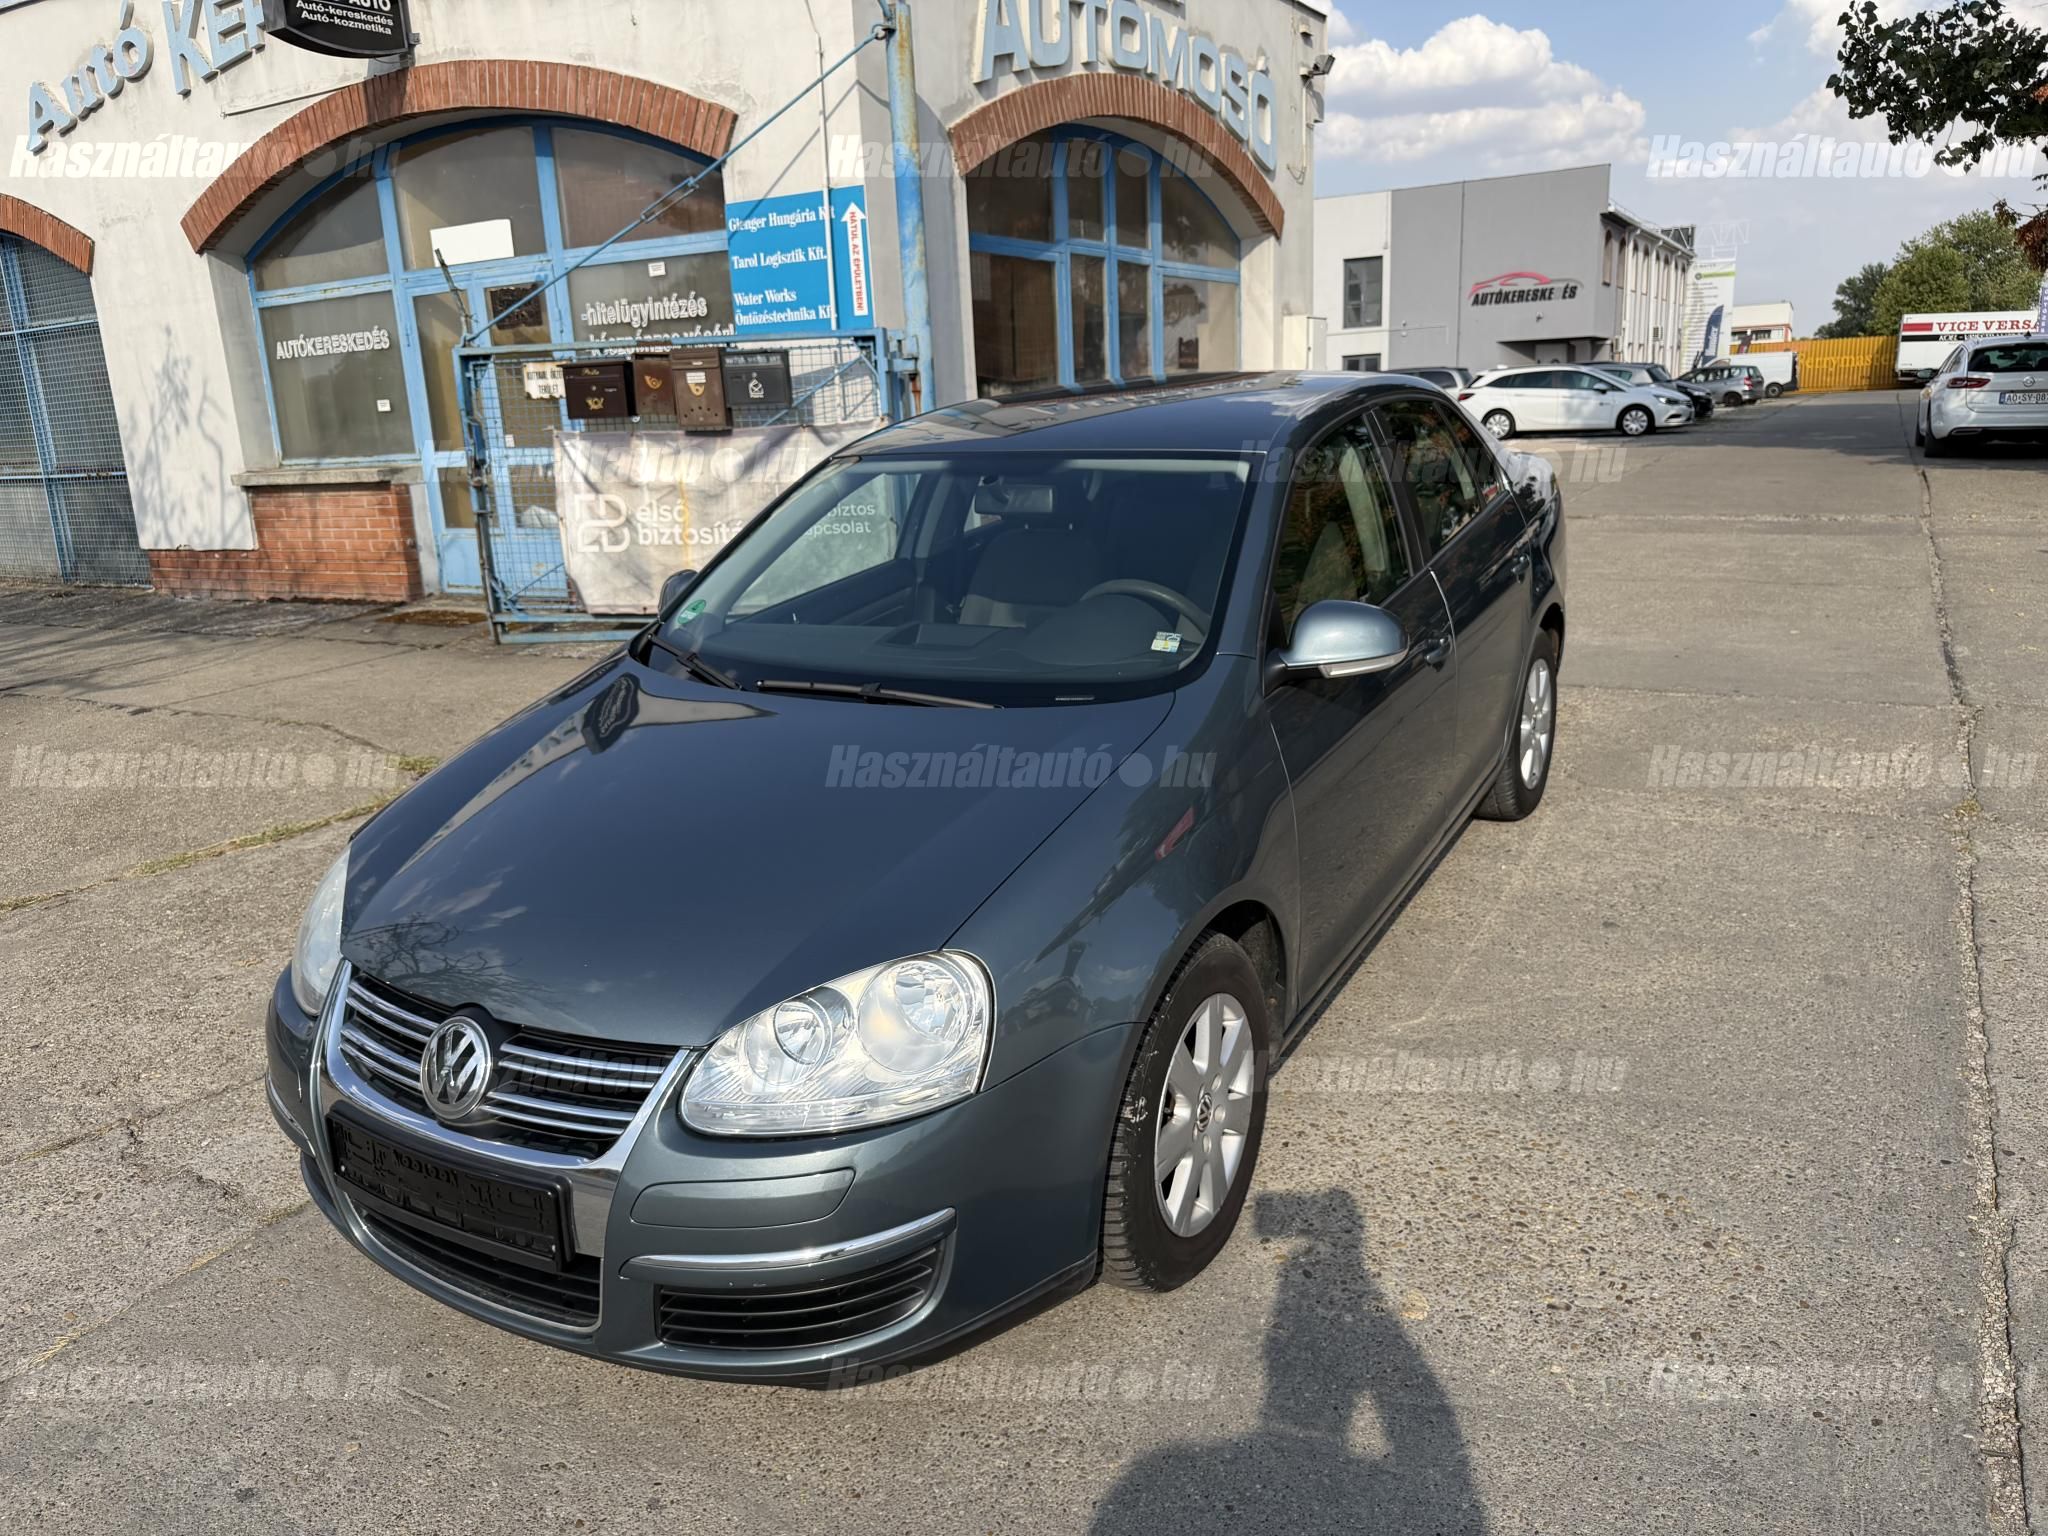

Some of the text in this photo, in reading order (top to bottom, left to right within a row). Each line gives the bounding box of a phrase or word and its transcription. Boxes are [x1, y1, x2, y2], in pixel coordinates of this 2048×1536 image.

[296, 0, 394, 26] Autó-kereskedés
[301, 10, 392, 35] Autó-kozmetika
[26, 0, 154, 156] Autó
[971, 0, 1278, 171] AUTOMOSÓ
[768, 208, 816, 228] Hungária
[732, 246, 828, 270] Tarol Logisztik Kft.
[734, 288, 797, 306] Water Works
[735, 307, 816, 327] Öntözéstechnika
[1936, 321, 1979, 332] VICE
[276, 325, 391, 360] AUTÓKERESKEDÉS
